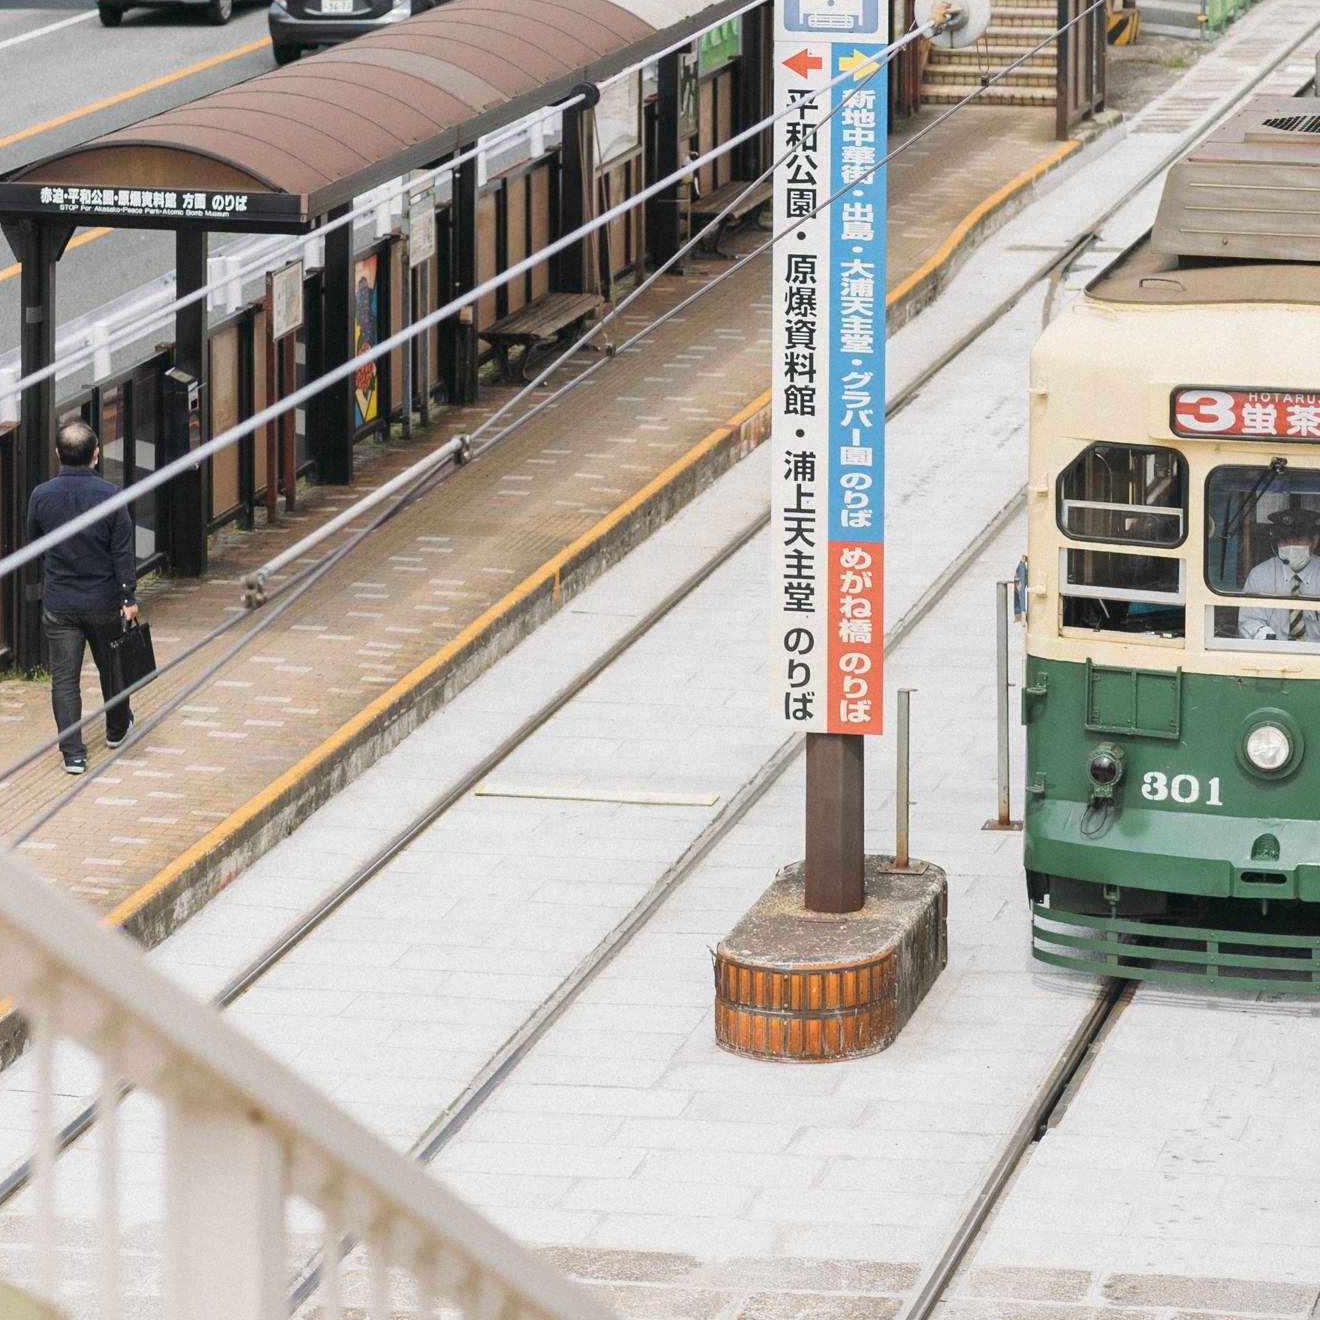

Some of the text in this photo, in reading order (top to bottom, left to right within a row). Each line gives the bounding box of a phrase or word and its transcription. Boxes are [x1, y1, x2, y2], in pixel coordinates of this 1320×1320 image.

[59, 203, 79, 211] STOP
[81, 204, 92, 212] For
[186, 209, 203, 217] Bomb
[205, 210, 230, 218] Museum
[182, 193, 206, 210] 方面
[212, 194, 248, 212] のりば
[783, 88, 819, 613] 平和公園・原爆資料館・浦上天主堂
[1176, 389, 1237, 432] 3
[839, 472, 873, 528] のりば
[838, 546, 873, 645] めがね橋
[783, 627, 816, 721] のりば
[838, 652, 872, 723] のりば
[1141, 771, 1223, 806] 301
